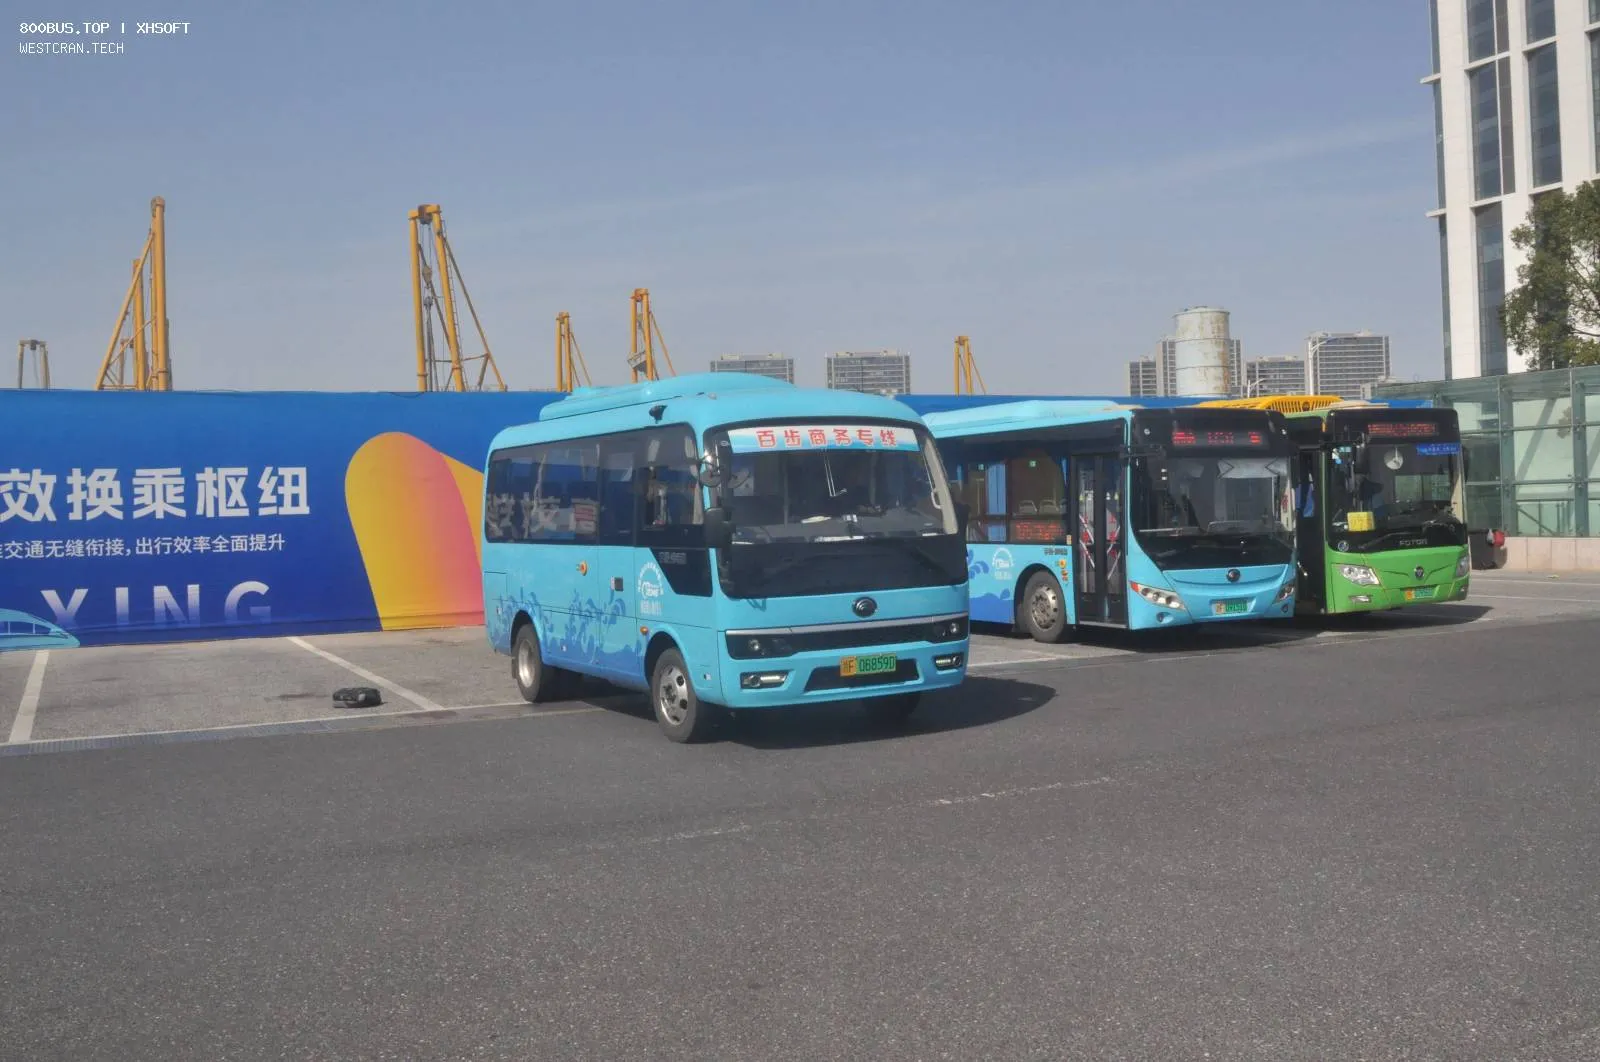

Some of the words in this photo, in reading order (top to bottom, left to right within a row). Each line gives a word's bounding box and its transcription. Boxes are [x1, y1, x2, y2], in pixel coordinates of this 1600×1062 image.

[755, 428, 898, 449] 百步商务专线
[0, 466, 310, 523] 效换乘枢纽
[0, 533, 286, 560] 交通无缝衔接，出行效率全面提升
